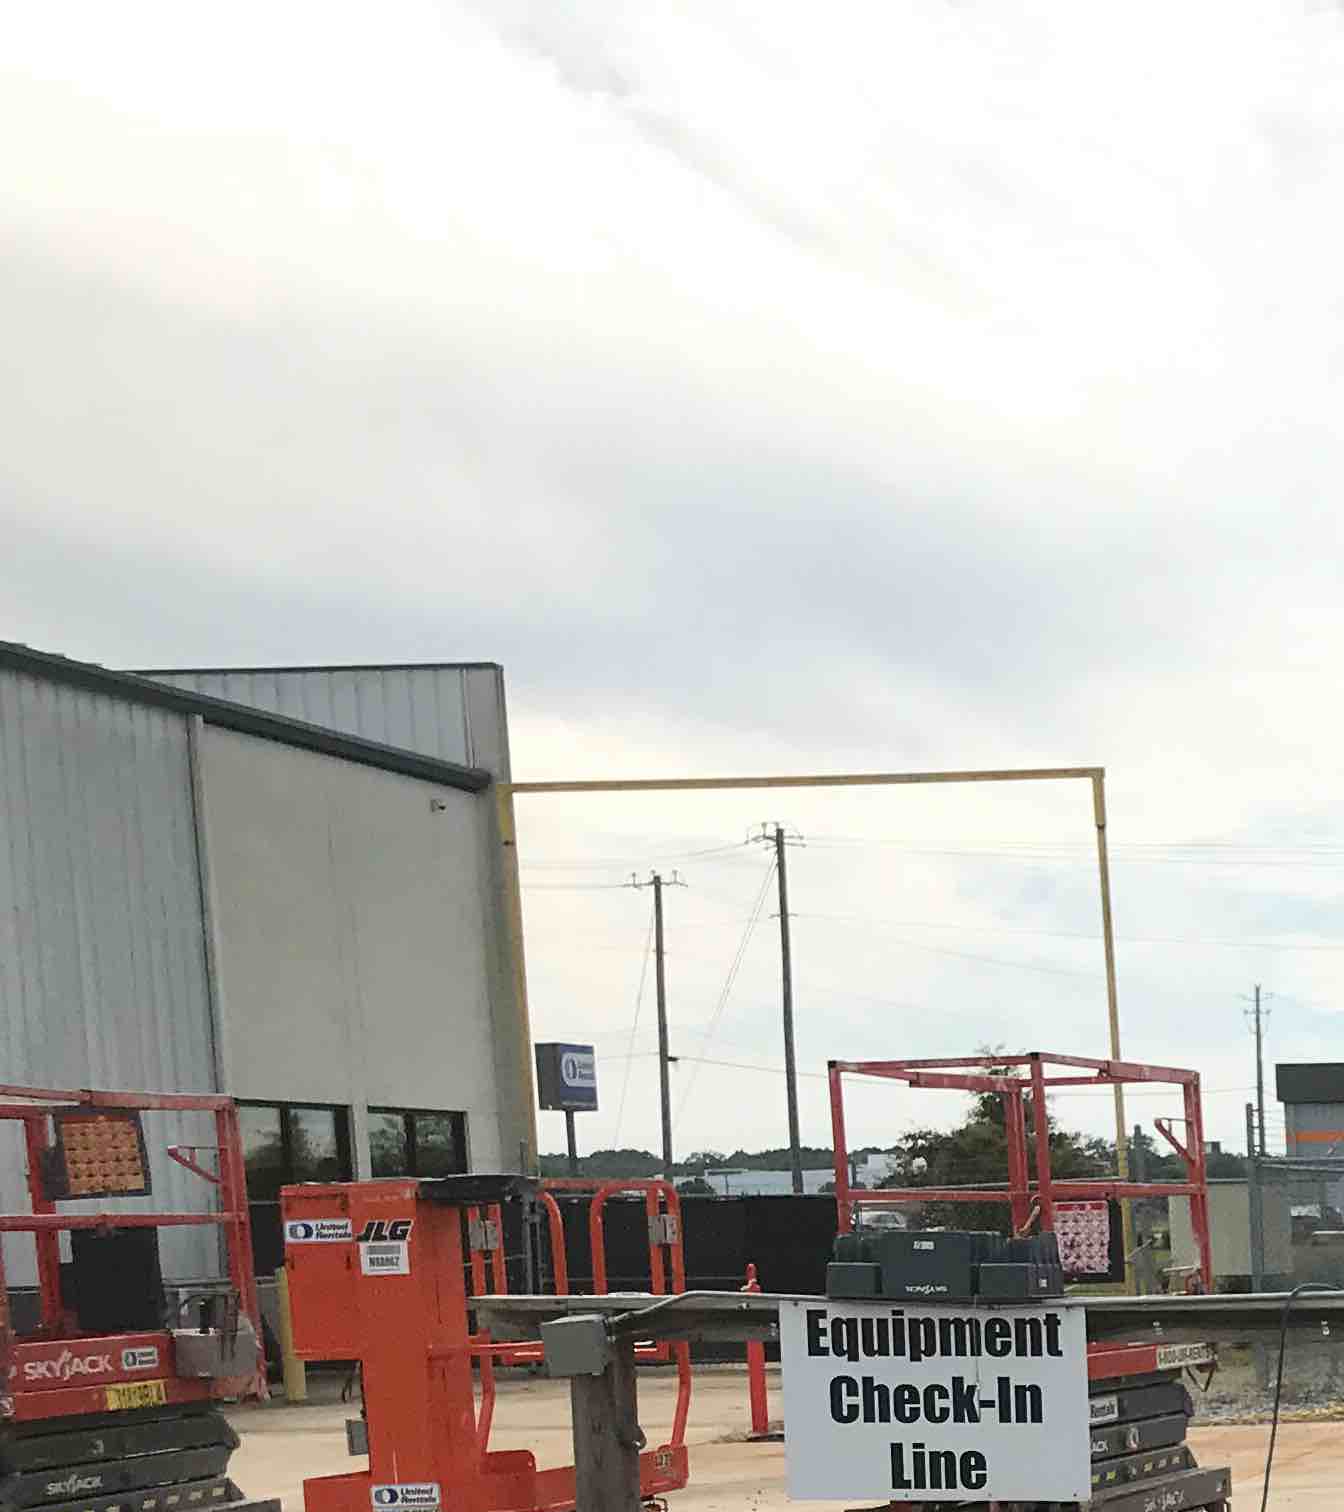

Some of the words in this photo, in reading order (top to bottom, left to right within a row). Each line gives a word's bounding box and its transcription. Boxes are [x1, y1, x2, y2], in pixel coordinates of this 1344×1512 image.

[356, 1221, 412, 1242] JLG
[806, 1309, 1063, 1362] Equipment
[23, 1349, 114, 1381] SKYJACK
[829, 1375, 1043, 1424] Check-In
[45, 1473, 103, 1496] SKYJACK
[890, 1442, 988, 1490] Line
